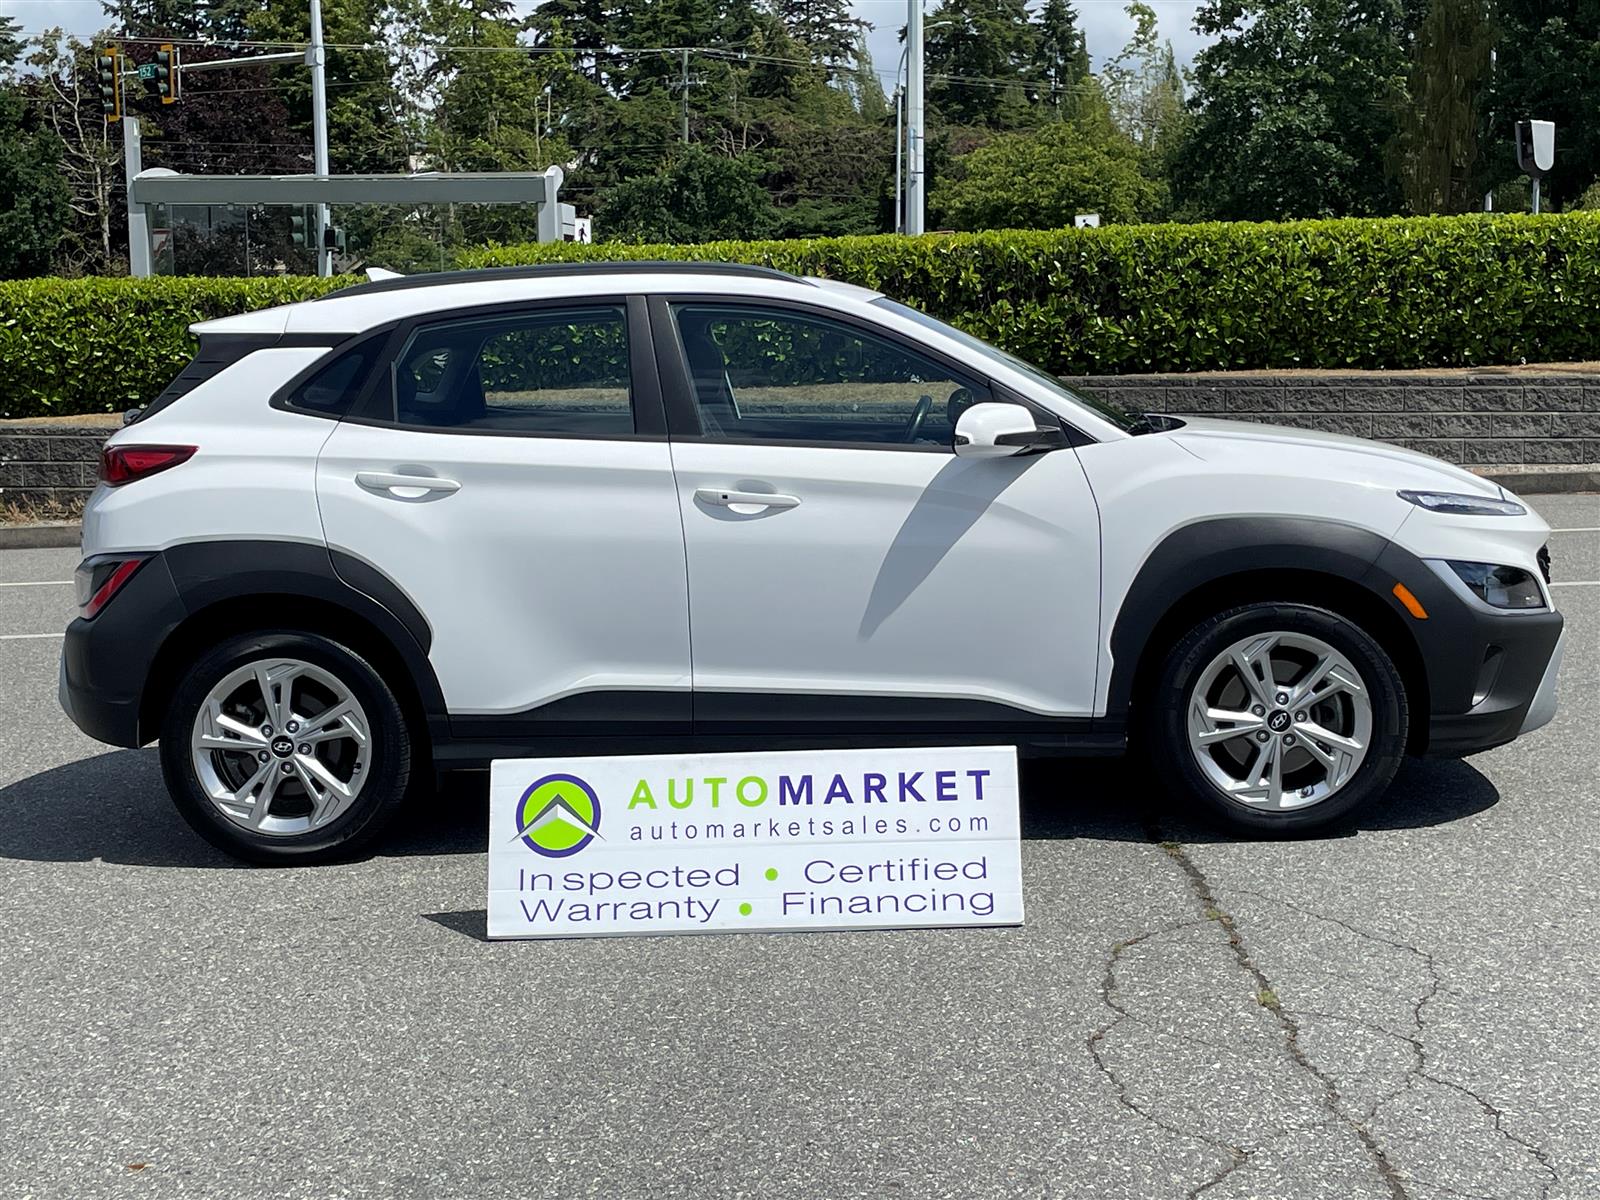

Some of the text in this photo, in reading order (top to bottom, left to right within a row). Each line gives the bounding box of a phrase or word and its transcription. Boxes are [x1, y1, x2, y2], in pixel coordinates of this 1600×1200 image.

[627, 769, 991, 810] AUTOMARKET
[629, 815, 989, 841] automarketsales.com
[519, 856, 988, 896] Inspected Certified
[519, 888, 995, 923] Warranty Financing
